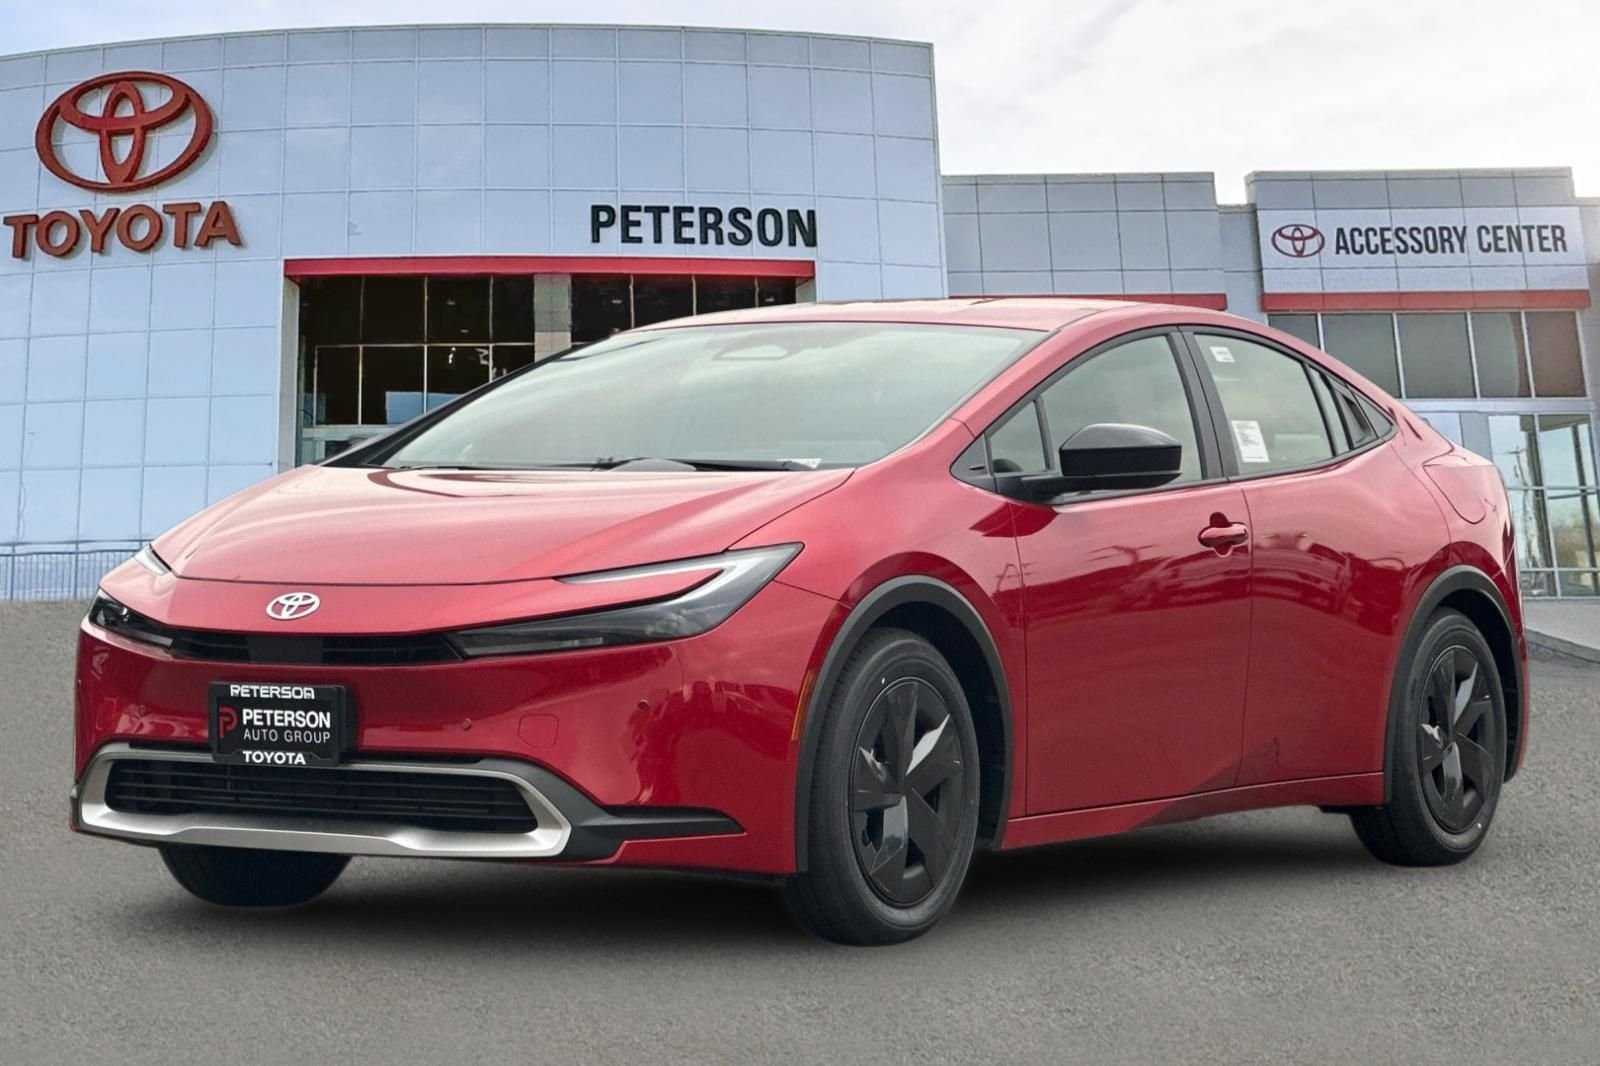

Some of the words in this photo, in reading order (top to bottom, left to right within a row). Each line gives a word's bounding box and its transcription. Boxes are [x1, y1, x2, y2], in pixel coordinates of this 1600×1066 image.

[3, 200, 242, 259] TOYOTA
[590, 204, 818, 248] PETERSON
[1335, 226, 1467, 255] ACCESSORY
[1477, 224, 1568, 253] CENTER
[242, 708, 331, 729] PETERSON
[243, 728, 279, 742] AUTO
[284, 729, 331, 744] GROUP
[242, 750, 307, 765] TOYOTA
